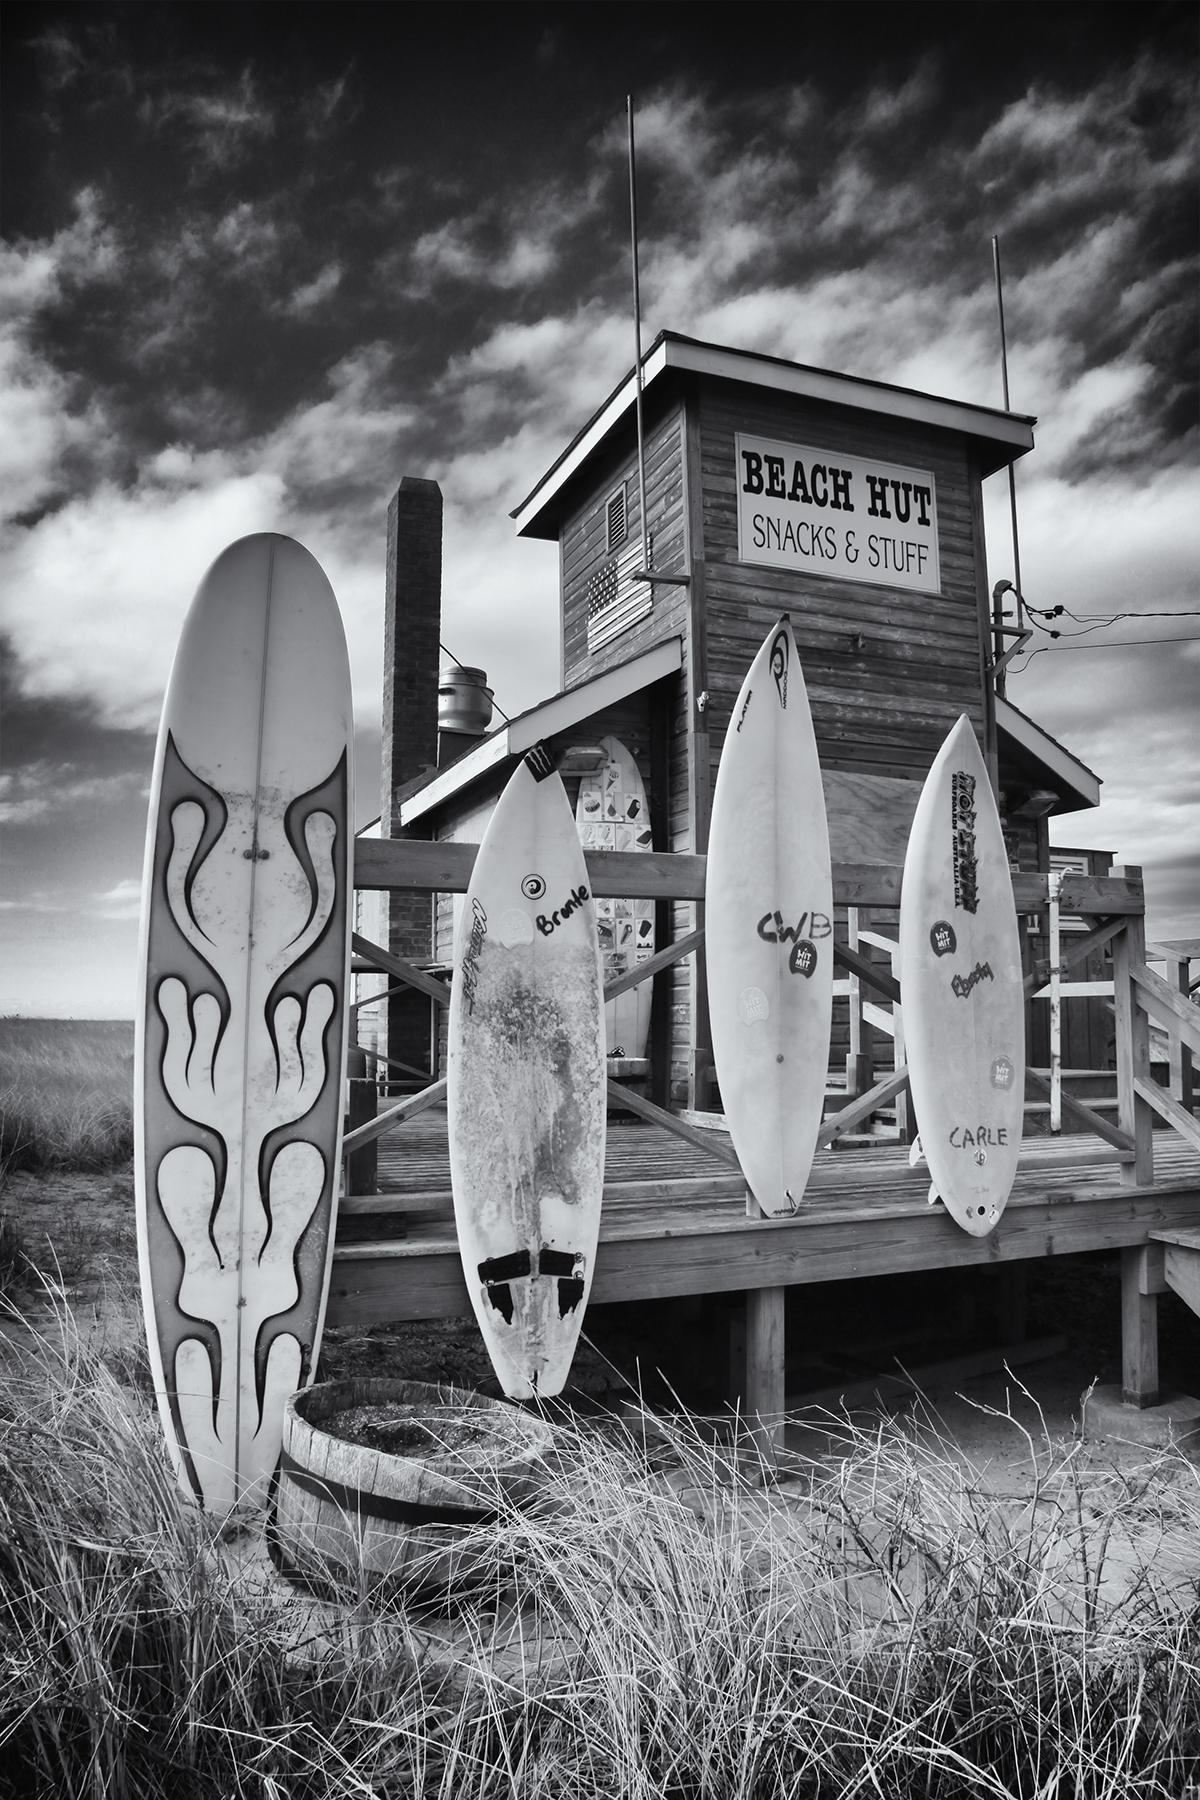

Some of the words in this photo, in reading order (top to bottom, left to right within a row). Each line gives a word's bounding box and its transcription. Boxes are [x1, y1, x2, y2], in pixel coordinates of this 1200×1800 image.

[741, 450, 854, 512] BEACH
[866, 475, 931, 527] HUT
[753, 514, 837, 560] SNACKS
[845, 531, 860, 563] &
[868, 534, 928, 575] STUFF
[949, 1125, 1008, 1149] CARLE
